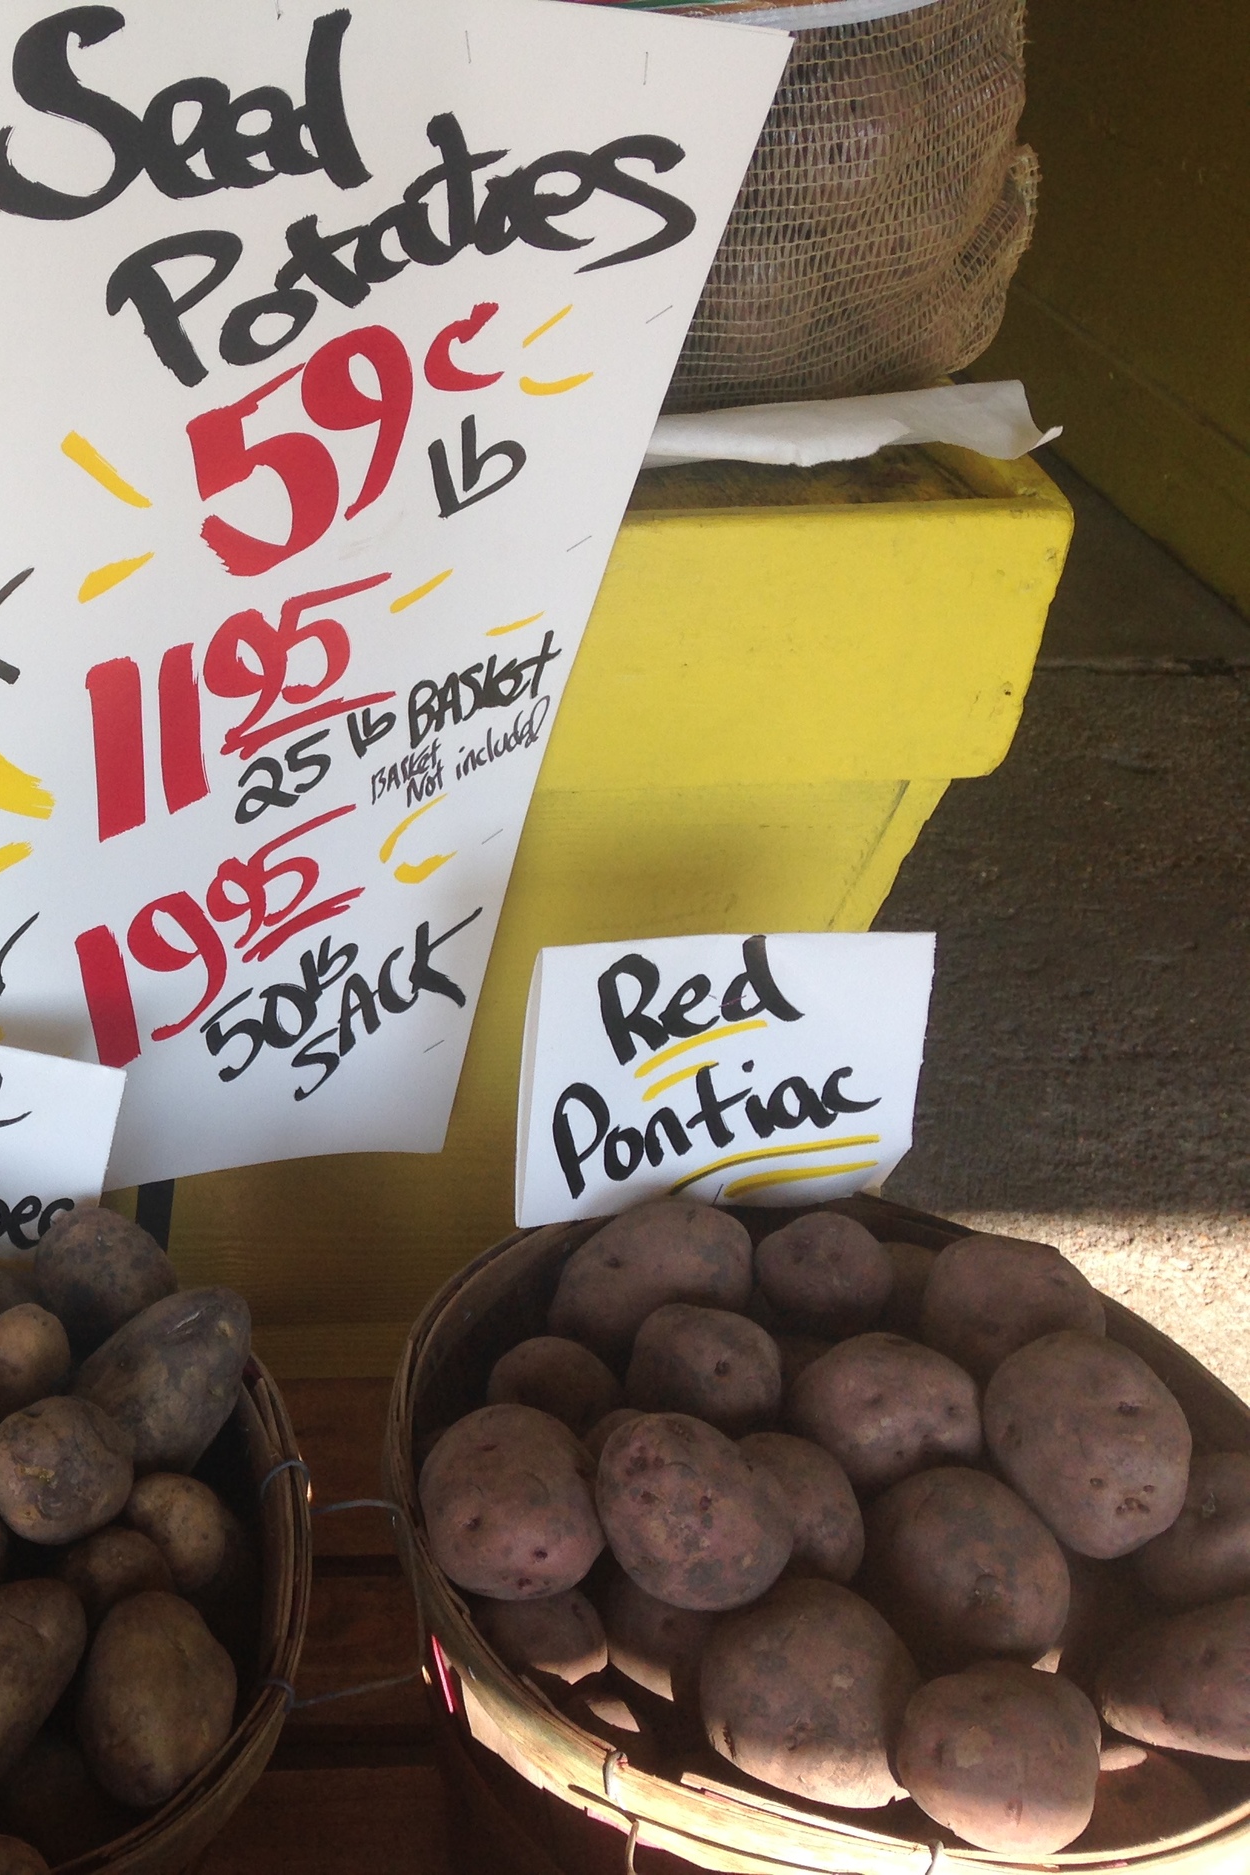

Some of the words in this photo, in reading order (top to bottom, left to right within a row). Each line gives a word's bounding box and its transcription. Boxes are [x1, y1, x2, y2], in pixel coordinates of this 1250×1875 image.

[106, 110, 697, 387] Potatoes
[427, 413, 527, 520] lb
[234, 729, 332, 824] 25
[347, 707, 397, 758] lb
[294, 907, 483, 1101] SACK
[598, 935, 805, 1065] Red
[552, 1060, 882, 1200] Pontiac
